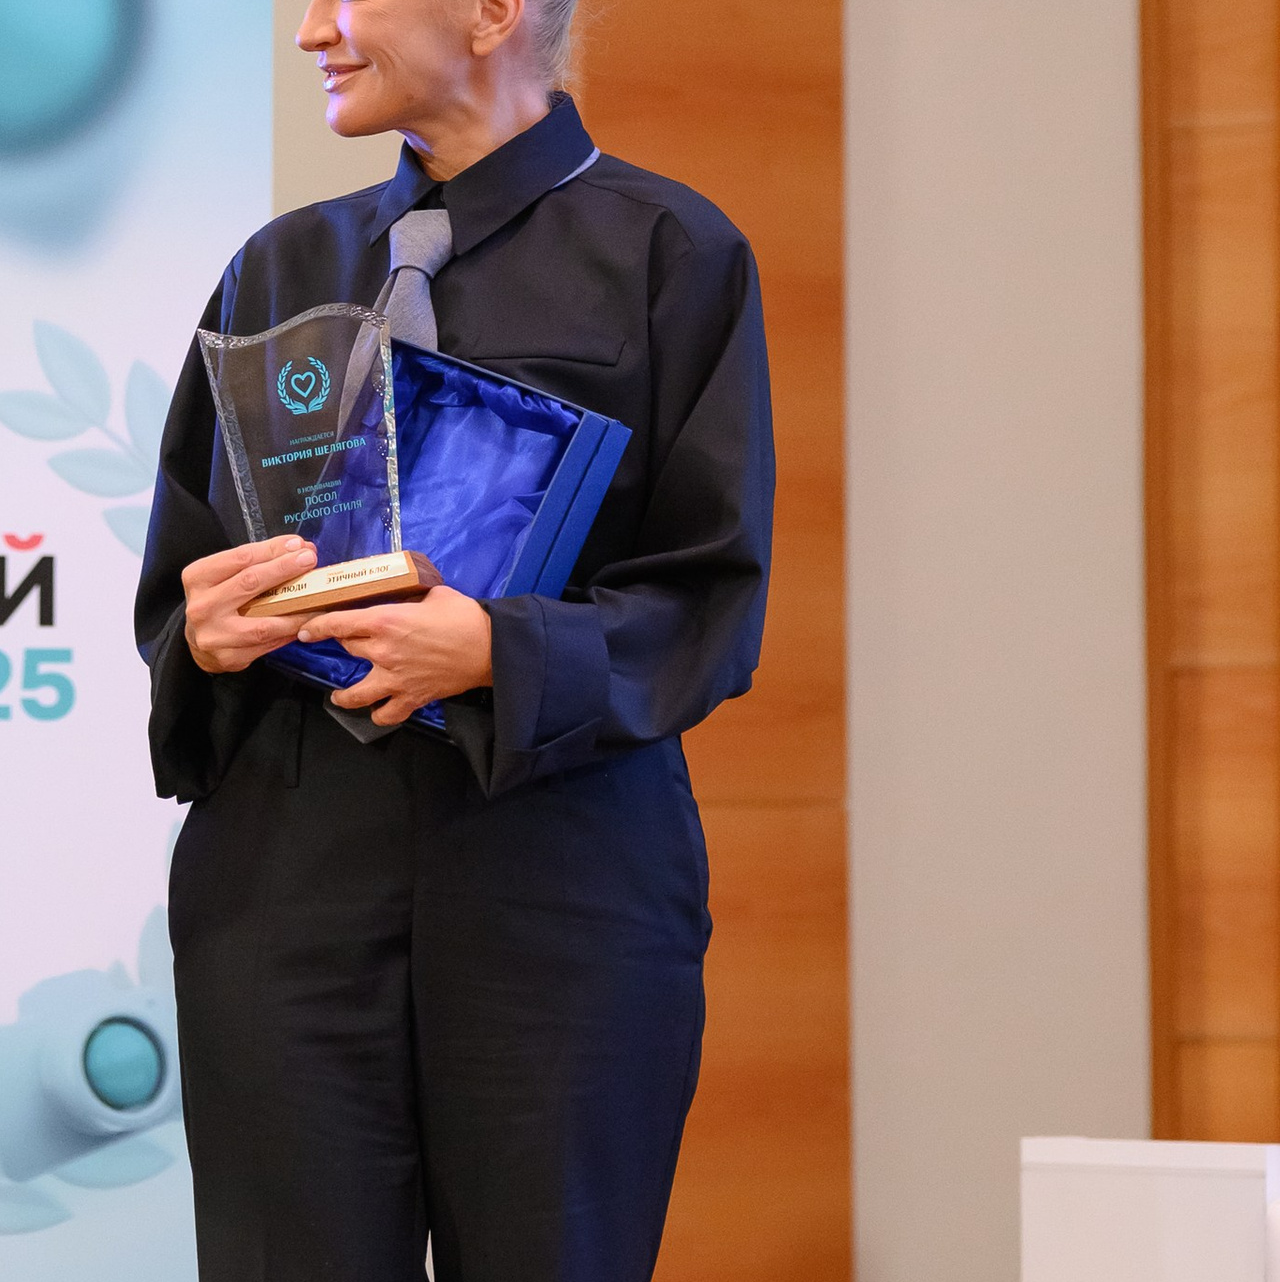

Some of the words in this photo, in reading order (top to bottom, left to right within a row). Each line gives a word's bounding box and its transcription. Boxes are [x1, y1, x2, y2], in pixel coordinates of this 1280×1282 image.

[261, 448, 313, 468] ВИКТОРИЯ
[314, 437, 366, 457] ШЕЛЯГОВА
[304, 491, 338, 507] ПОСОЛ
[284, 506, 331, 524] РУССКОГО
[332, 499, 362, 514] СТИЛЯ
[326, 568, 367, 585] ЭТИЧНЫЙ
[368, 564, 391, 575] БЛОГ
[280, 582, 308, 594] ЛЮДИ
